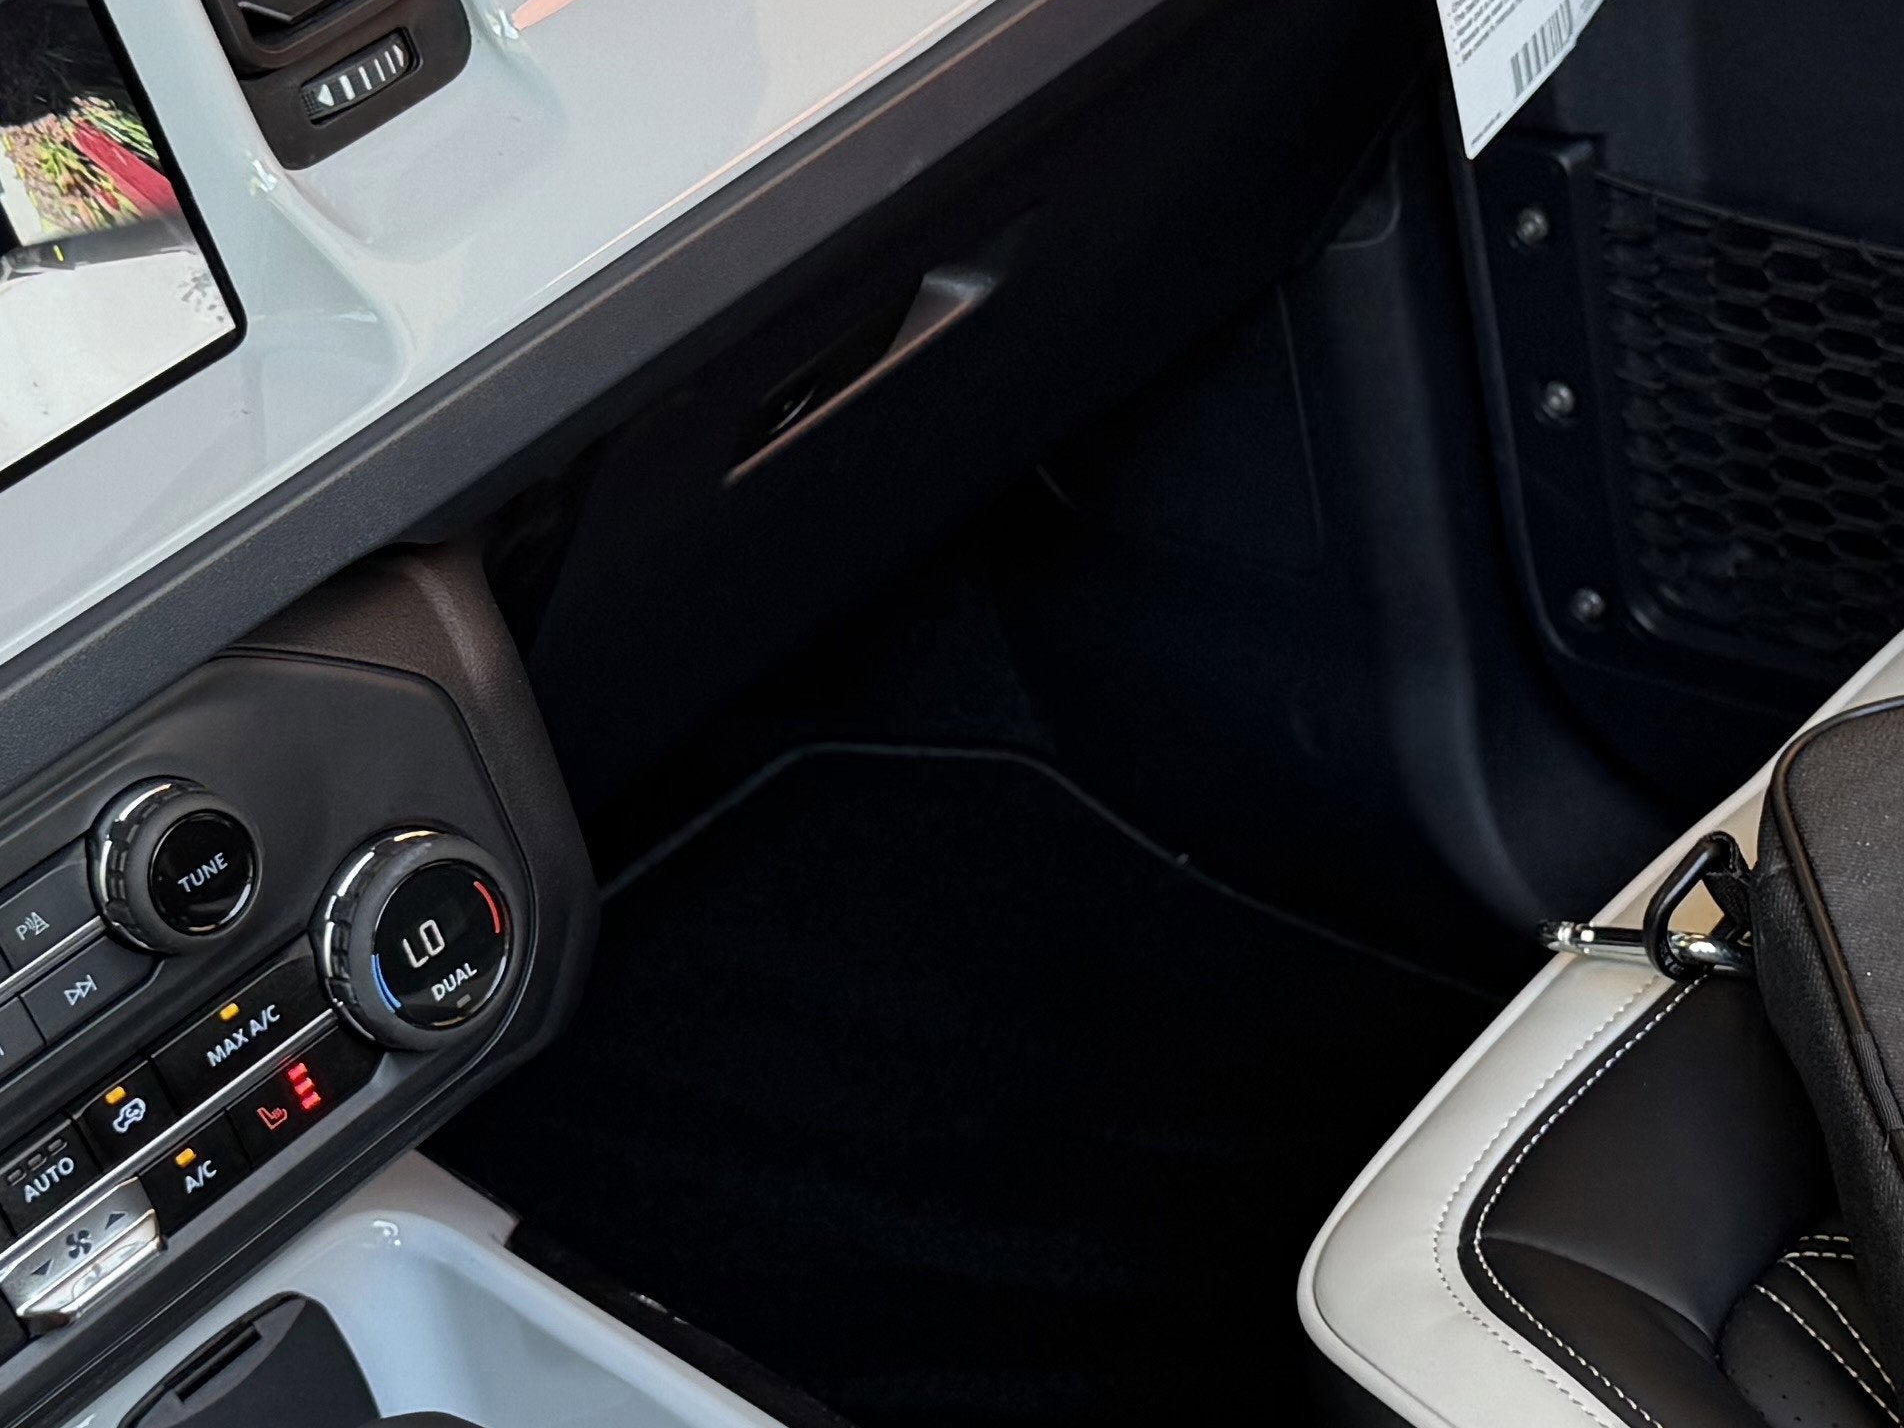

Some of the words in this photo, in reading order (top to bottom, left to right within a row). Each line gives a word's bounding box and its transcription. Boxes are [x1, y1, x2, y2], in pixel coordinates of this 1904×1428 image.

[178, 852, 228, 893] TUNE
[402, 919, 445, 968] LO
[431, 962, 478, 1002] DUAL
[206, 1028, 249, 1068] MAX
[249, 1004, 281, 1038] A/C
[23, 1155, 75, 1204] AUTO
[184, 1159, 218, 1195] A/C
